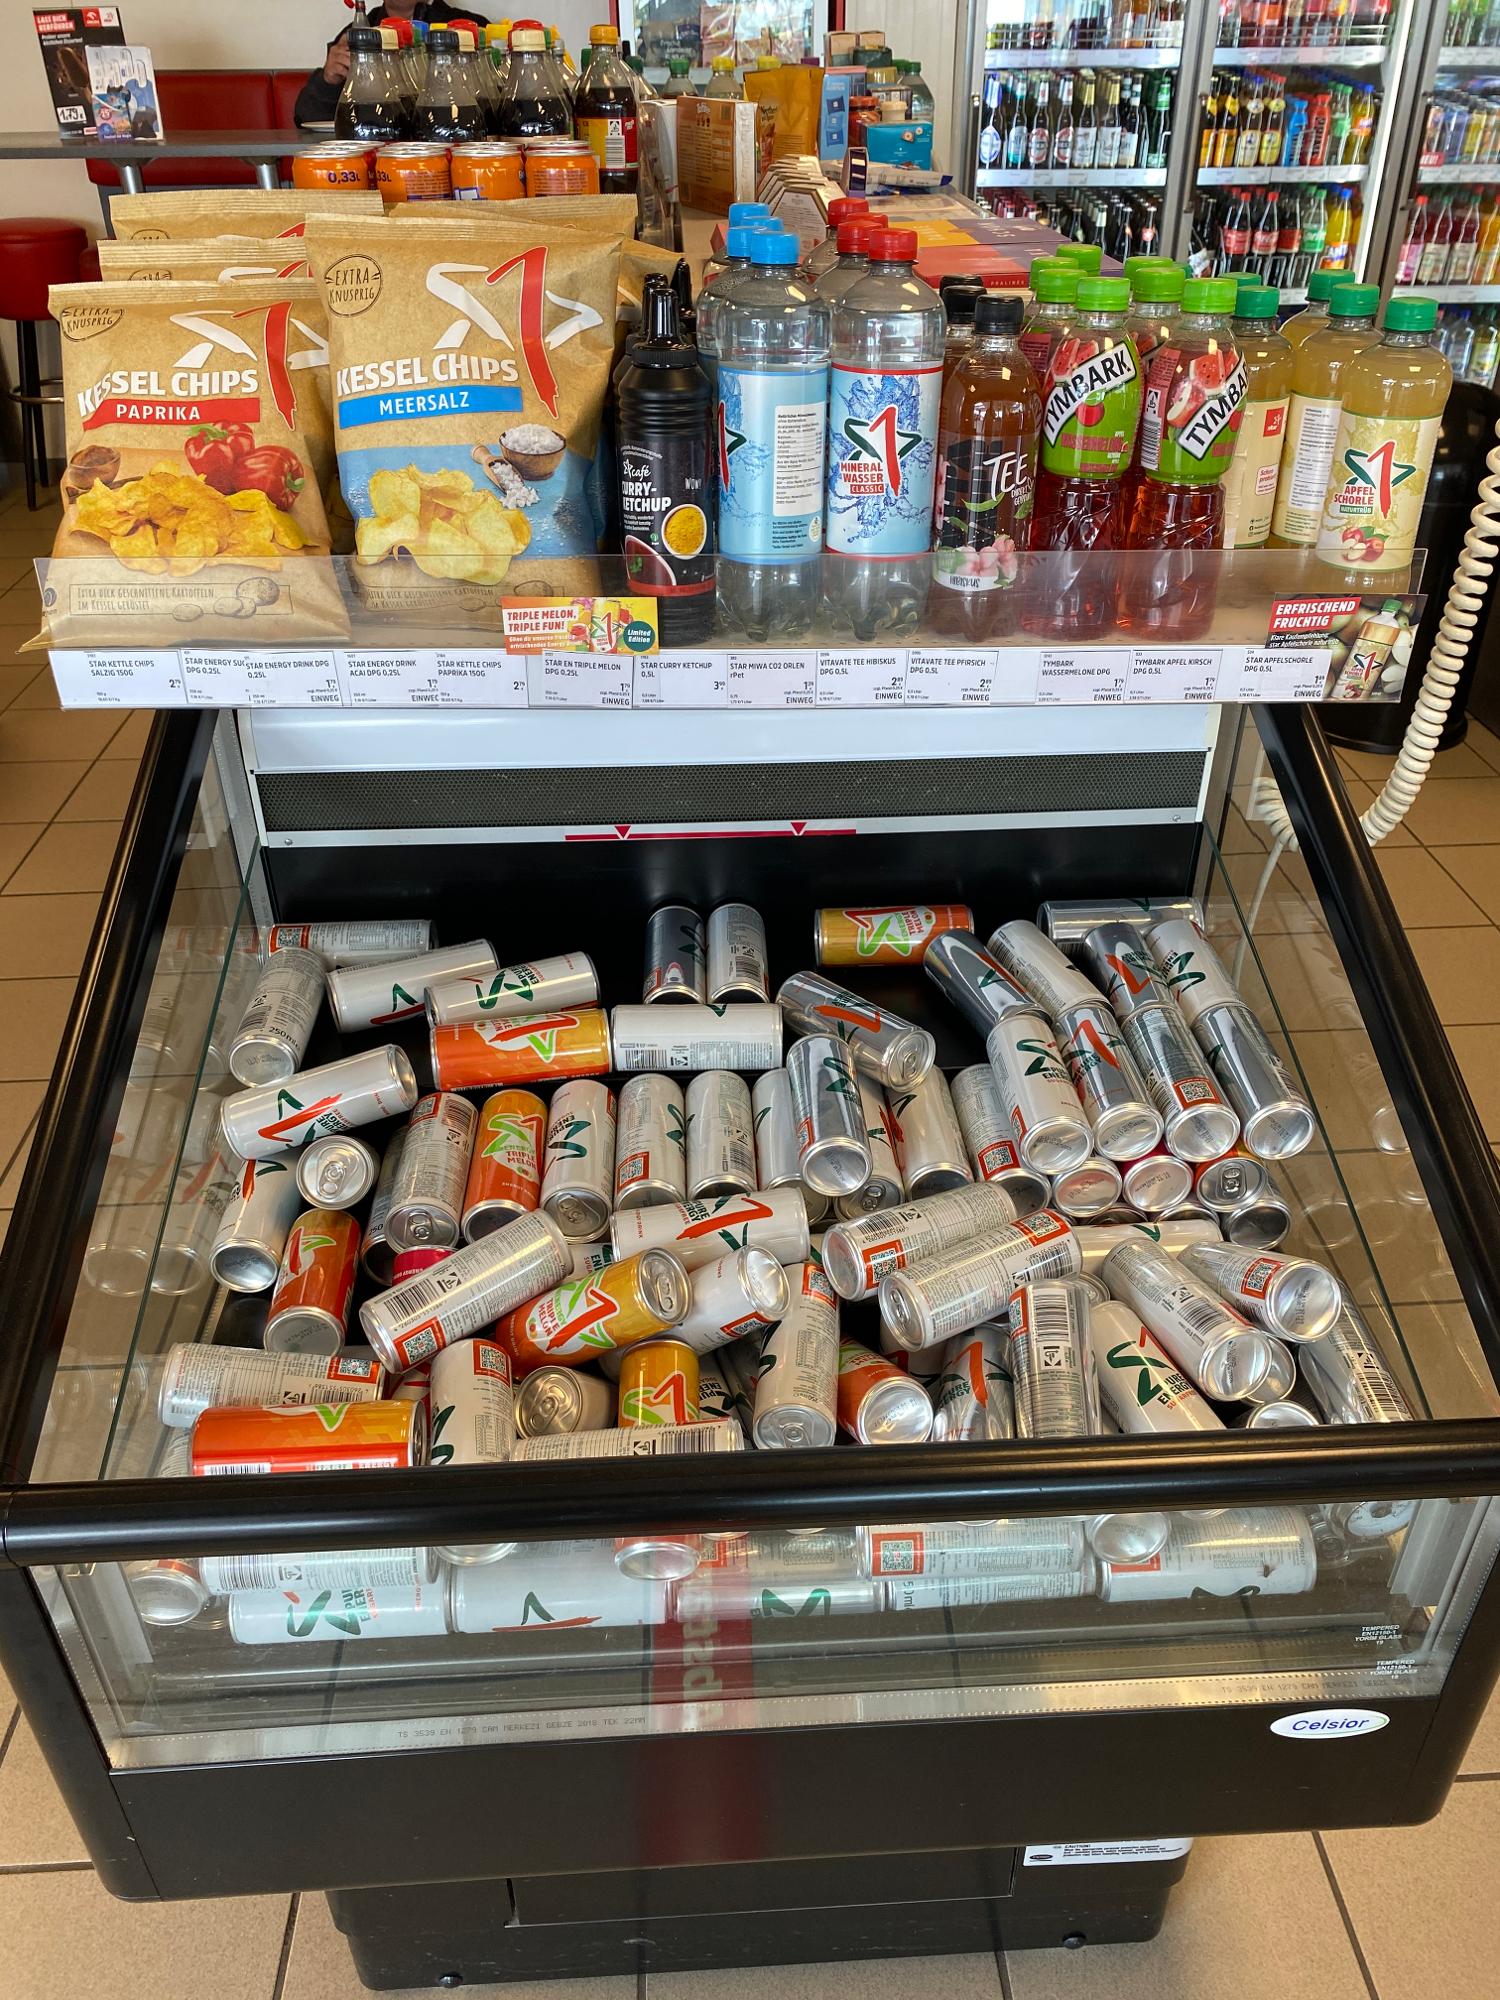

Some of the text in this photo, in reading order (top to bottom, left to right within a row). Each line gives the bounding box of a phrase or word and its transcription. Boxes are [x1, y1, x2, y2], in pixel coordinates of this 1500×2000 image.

[335, 267, 370, 286] EXTRA
[328, 287, 375, 304] KNUSPRIG
[72, 306, 110, 317] EXTRA
[66, 316, 113, 332] KNUSPRIG
[336, 352, 519, 398] KESSEL CHIPS
[78, 369, 259, 418] KESSEL CHIPS
[1045, 350, 1132, 433] TYMBARK
[379, 391, 471, 416] MEERSALZ
[116, 403, 201, 421] PAPRIKA
[630, 464, 652, 482] café
[840, 462, 884, 473] MINERAL
[842, 473, 884, 483] WASSER
[982, 452, 1028, 502] TEE
[851, 484, 883, 493] CLASSIC
[1344, 486, 1374, 496] APFEL
[1334, 494, 1374, 506] SCHORLE
[1340, 504, 1372, 514] NATURTRÜB
[118, 586, 171, 598] GESCHNITTENE
[172, 586, 214, 598] KARTOFFELN
[90, 600, 116, 611] KESSEL
[1276, 600, 1356, 615] ERFRISCHEND
[508, 609, 576, 621] TRIPLE MELON,
[508, 620, 564, 632] TRIPLE FUN!
[1272, 616, 1330, 629] FRUCHTIG
[627, 629, 651, 637] Limited
[88, 660, 108, 668] STAR
[184, 657, 232, 666] STAR ENERGY
[264, 661, 292, 670] ENERGY
[574, 661, 597, 669] TRIPLE
[598, 662, 621, 670] MELON
[910, 658, 942, 666] VITAVATE
[956, 659, 986, 667] PFIRSICH
[910, 666, 924, 674] DPG
[1096, 668, 1111, 676] DPG
[310, 694, 340, 702] EINWEG
[602, 697, 630, 706] EINWEG
[875, 692, 903, 700] EINWEG
[962, 693, 990, 702] EINWEG
[1093, 693, 1122, 702] EINWEG
[506, 1150, 536, 1162] TRIPLE
[507, 1157, 537, 1170] MELON
[538, 1302, 553, 1336] MELON
[546, 1298, 560, 1332] TRIPLE
[414, 1730, 435, 1738] 3539
[624, 1716, 646, 1725] 22MM
[1292, 1718, 1370, 1731] Celsior
